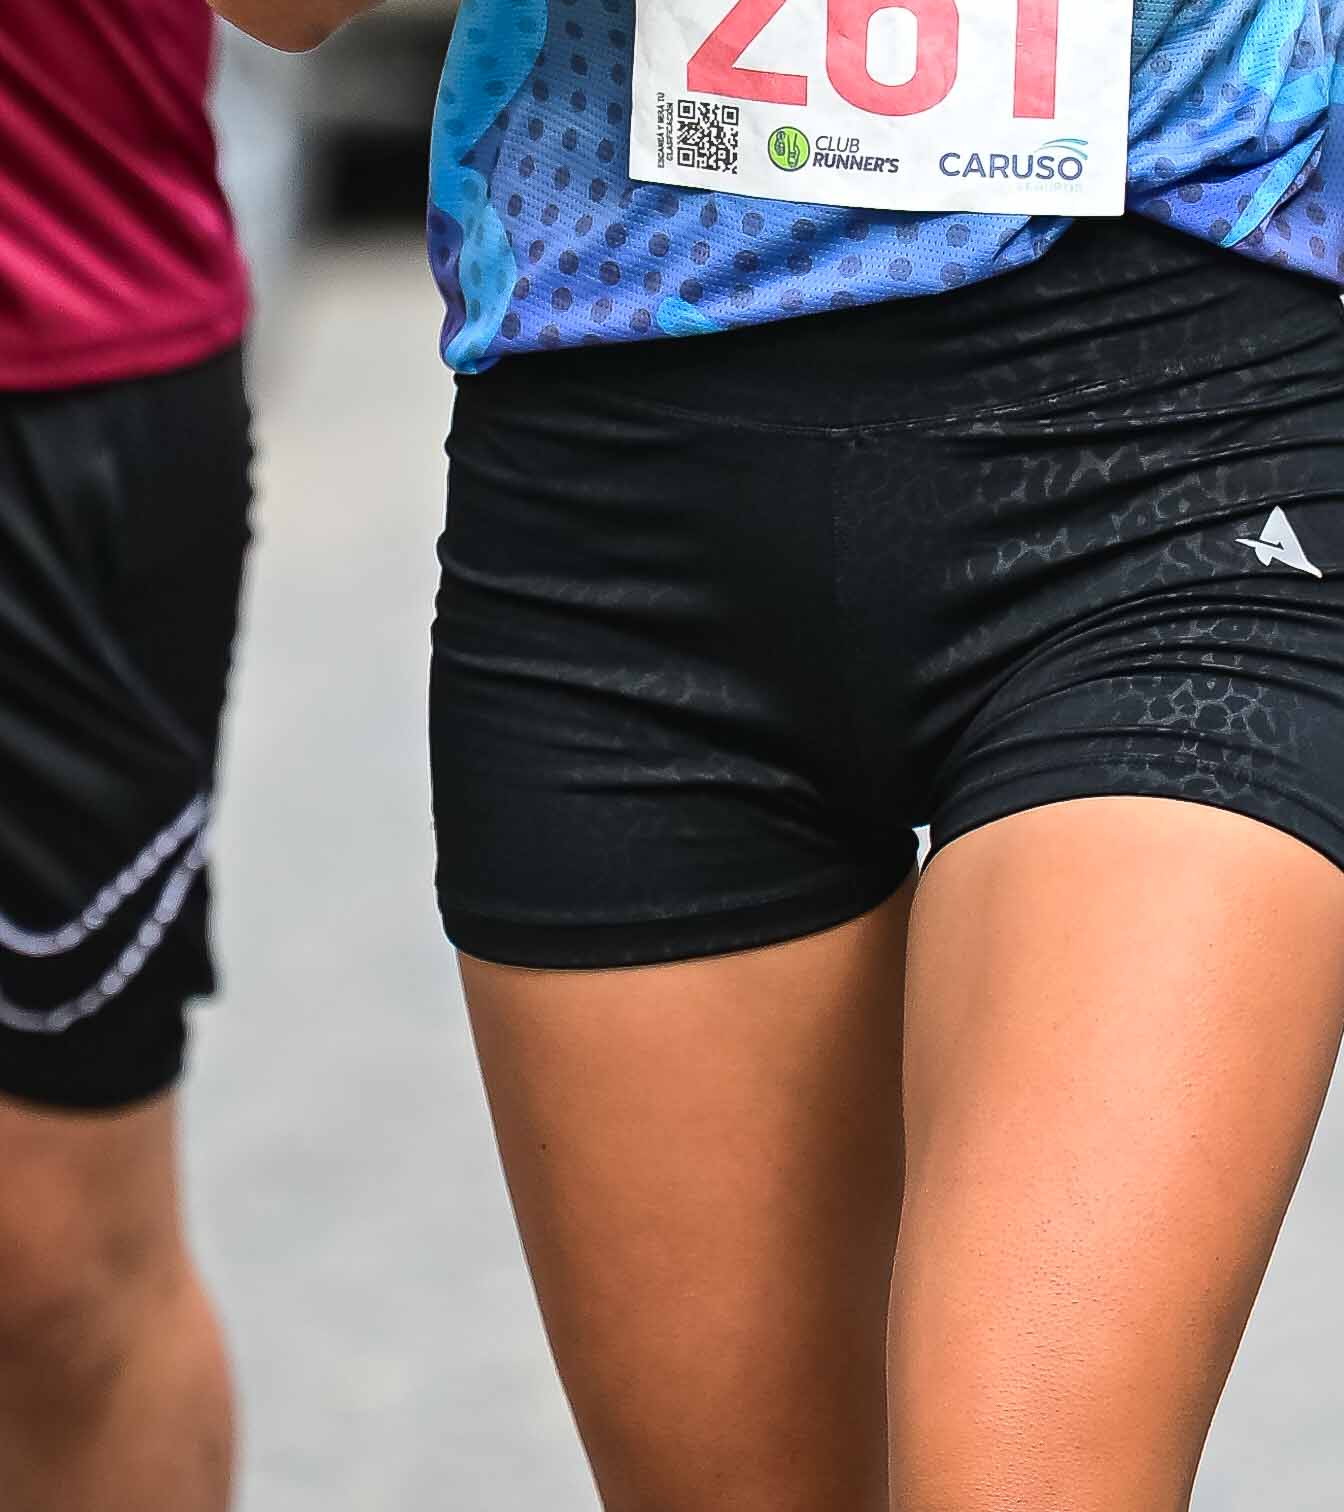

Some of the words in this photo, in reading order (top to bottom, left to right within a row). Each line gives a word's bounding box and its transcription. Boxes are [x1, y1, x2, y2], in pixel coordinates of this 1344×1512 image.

[815, 135, 860, 153] CLUB
[812, 152, 899, 173] RUNNER'S
[939, 152, 1083, 181] CARUSO
